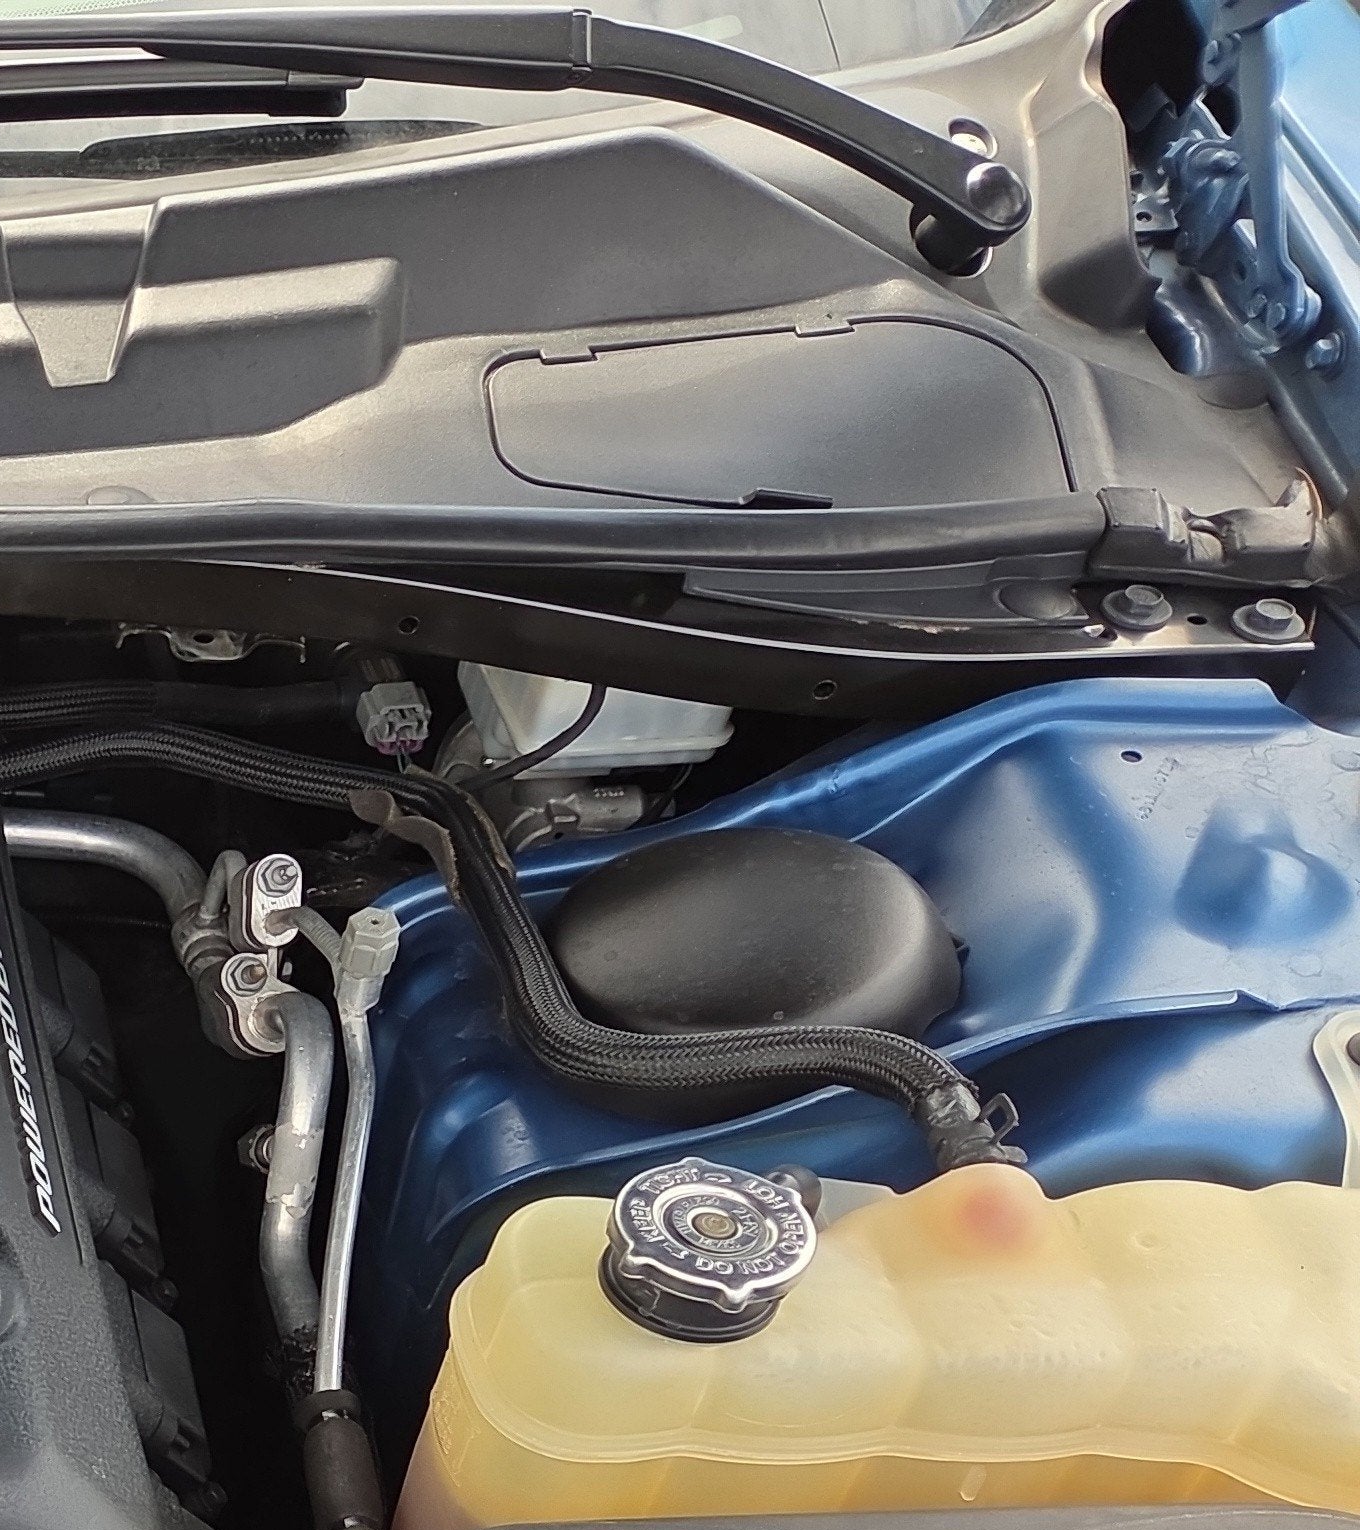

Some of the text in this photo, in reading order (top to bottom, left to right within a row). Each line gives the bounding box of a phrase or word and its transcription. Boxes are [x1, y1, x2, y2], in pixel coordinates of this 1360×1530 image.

[637, 1167, 701, 1195] TIGHT
[743, 1179, 791, 1211] HOT
[695, 1255, 734, 1275] DO
[736, 1251, 786, 1276] NOT
